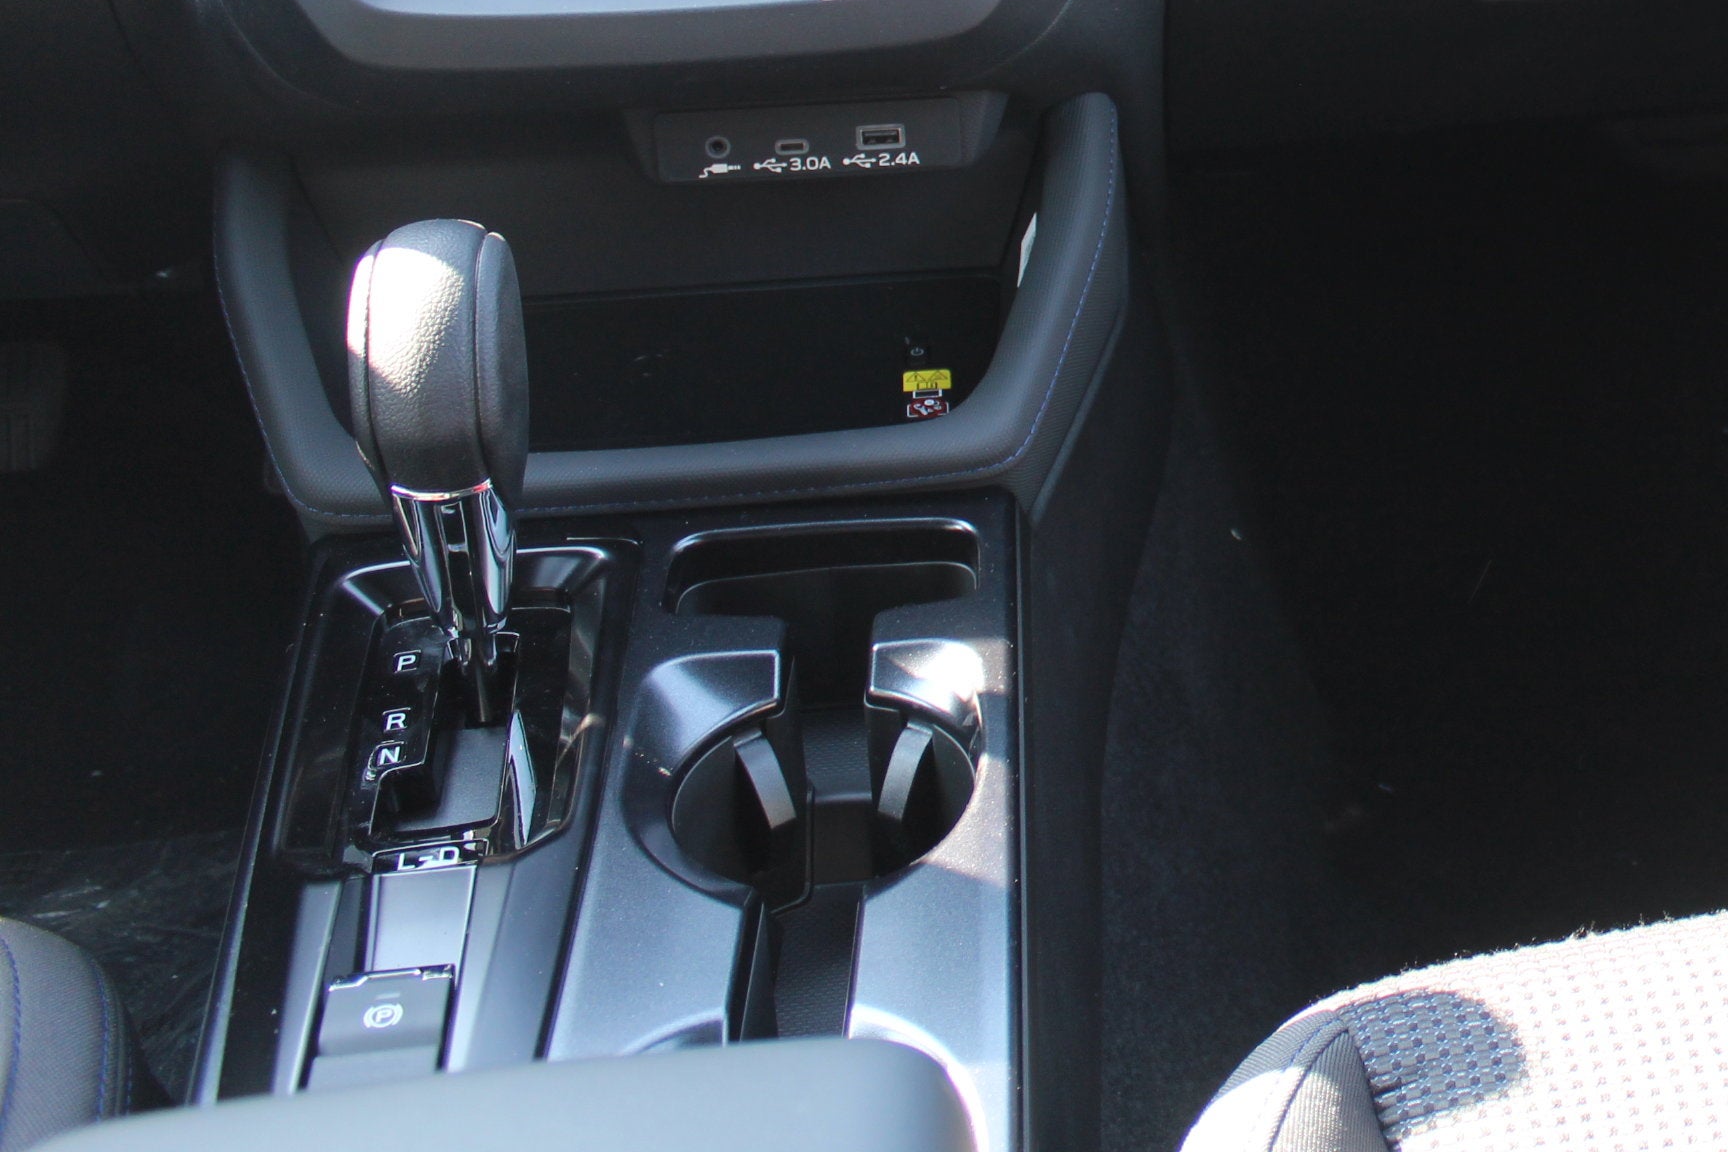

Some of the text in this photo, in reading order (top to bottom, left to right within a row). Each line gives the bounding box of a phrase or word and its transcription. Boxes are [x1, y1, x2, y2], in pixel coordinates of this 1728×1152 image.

[790, 157, 831, 171] 3.0A
[878, 152, 920, 166] 2.4A
[397, 656, 416, 671] P
[385, 713, 406, 730] R
[379, 747, 401, 763] N
